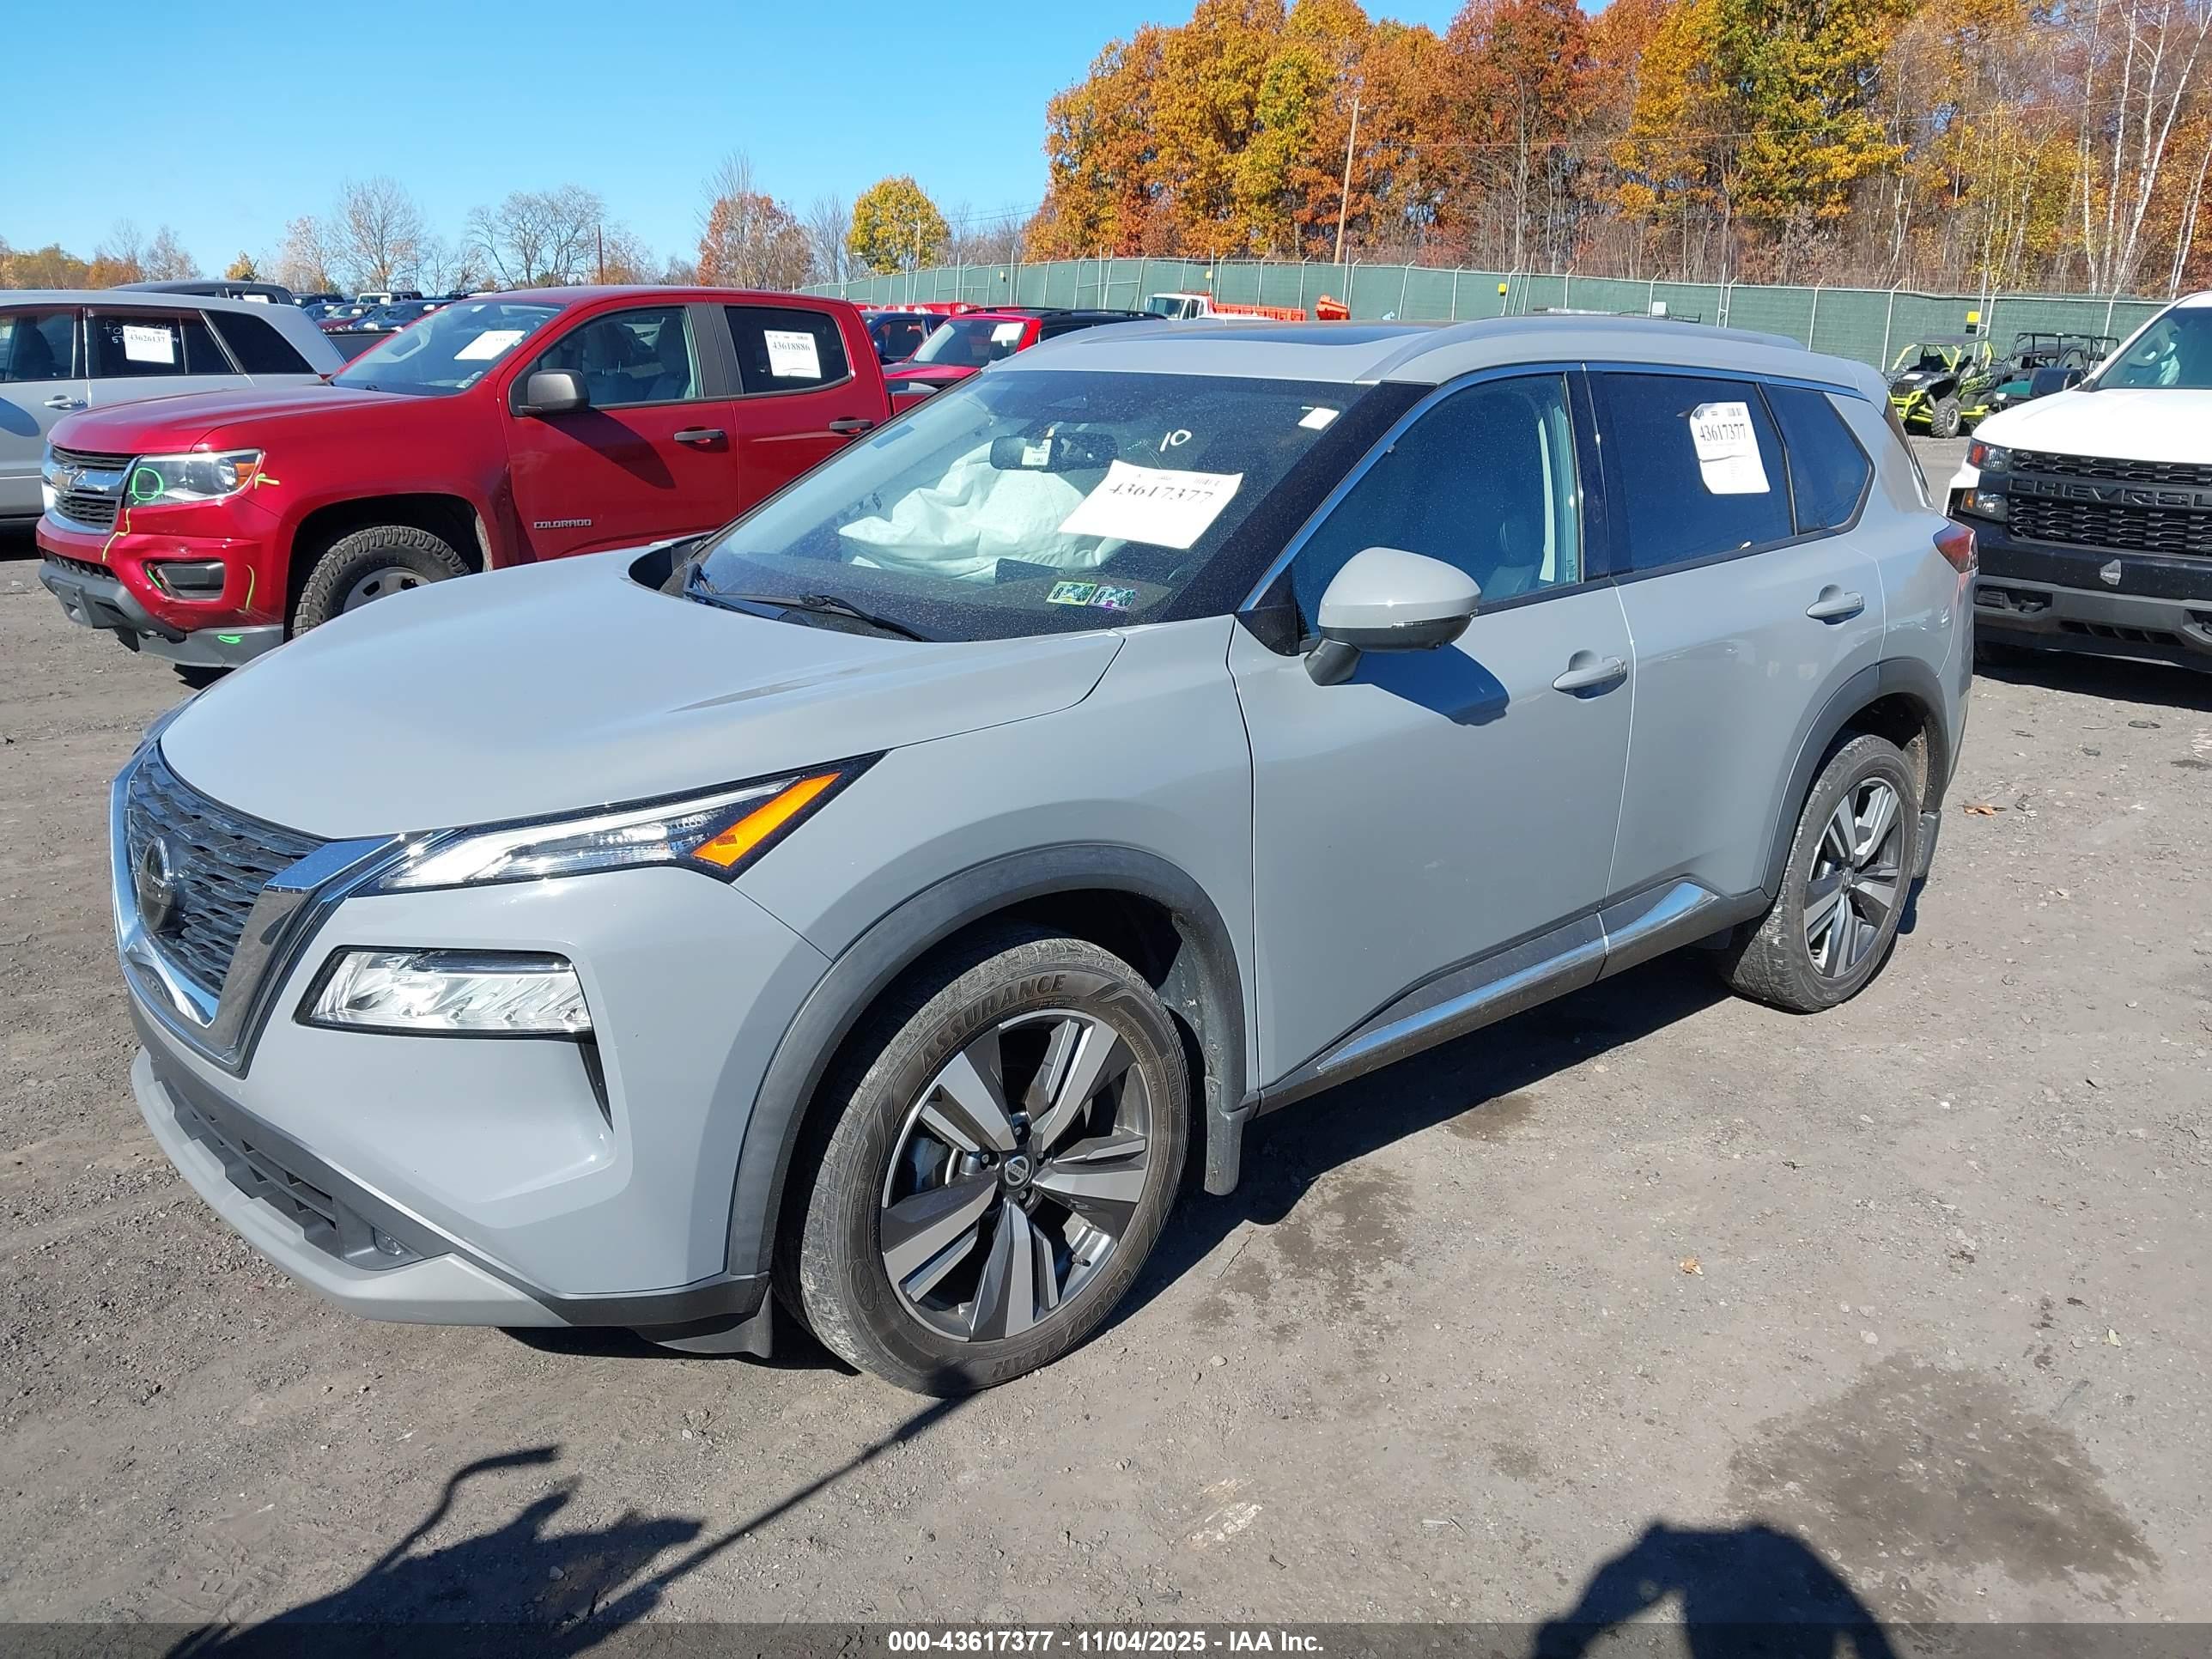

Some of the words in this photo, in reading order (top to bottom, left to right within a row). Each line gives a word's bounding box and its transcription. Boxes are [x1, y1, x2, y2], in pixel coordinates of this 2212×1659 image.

[129, 333, 165, 343] 43626137
[772, 341, 811, 351] 43618886
[1159, 429, 1192, 452] 10
[1699, 422, 1747, 441] 43617377
[1109, 482, 1214, 503] 43617377
[533, 519, 592, 529] COLORADO
[921, 974, 1066, 1073] ASSURANCE
